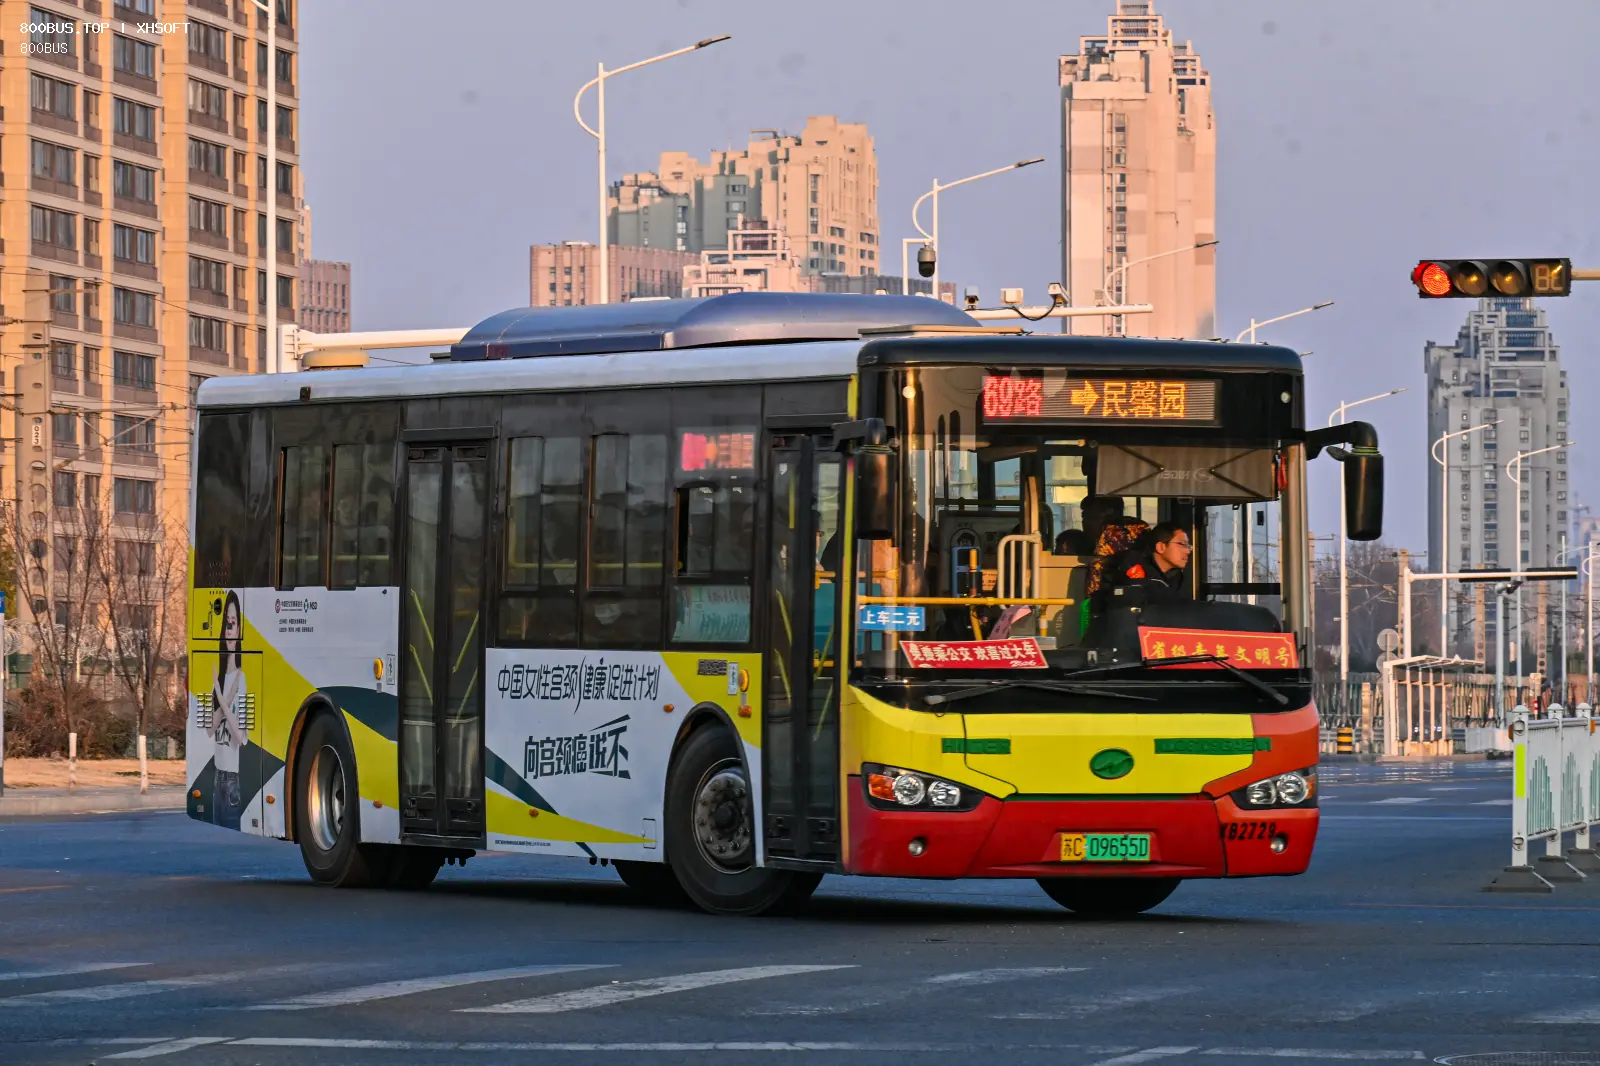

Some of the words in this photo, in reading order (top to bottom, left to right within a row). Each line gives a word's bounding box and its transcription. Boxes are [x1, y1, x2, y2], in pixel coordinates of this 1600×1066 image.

[1101, 381, 1186, 418] 民馨园
[862, 610, 921, 626] 上车二元
[973, 641, 1038, 661] 欢喜过大年
[523, 714, 632, 780] 向宫颈癌说不
